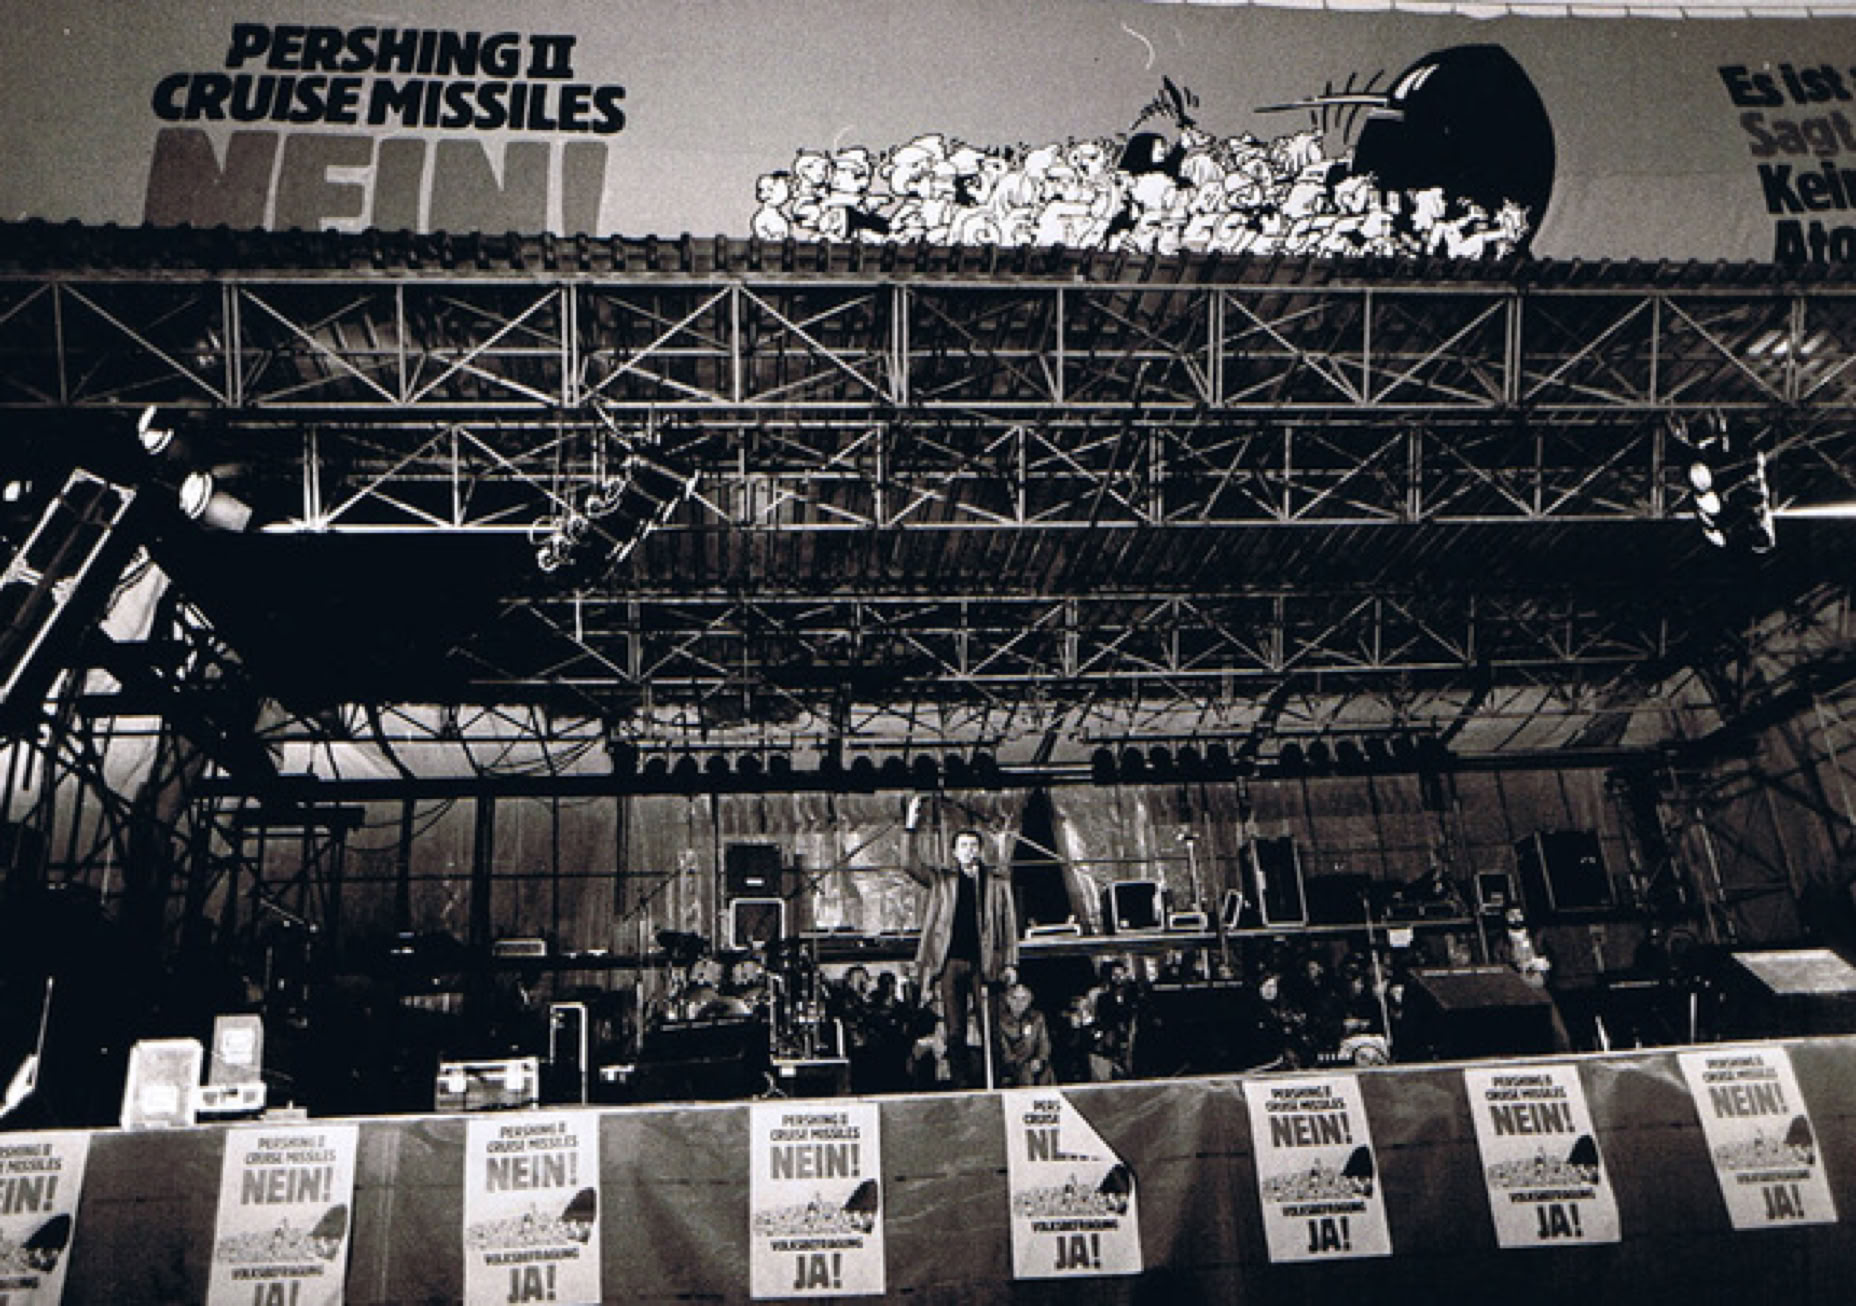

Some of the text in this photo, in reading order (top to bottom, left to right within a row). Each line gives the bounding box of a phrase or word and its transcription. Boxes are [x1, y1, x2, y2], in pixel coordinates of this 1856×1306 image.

[224, 23, 576, 79] PERSHING II
[151, 72, 626, 133] CRUISE MISSILES
[1718, 63, 1853, 107] Es ist
[143, 127, 609, 234] NEIN!
[1488, 1102, 1575, 1135] NEIN!
[1708, 1082, 1789, 1118] NEIN!
[1269, 1112, 1352, 1147] NEIN!
[486, 1152, 577, 1193] NEIN!
[770, 1143, 860, 1179] NEIN!
[240, 1166, 333, 1205] NEIN!
[1762, 1184, 1804, 1219] JA!
[1308, 1216, 1352, 1253] JA!
[1537, 1203, 1584, 1239] JA!
[1054, 1233, 1102, 1270] JA!
[507, 1265, 556, 1303] JA!
[793, 1253, 842, 1289] JA!
